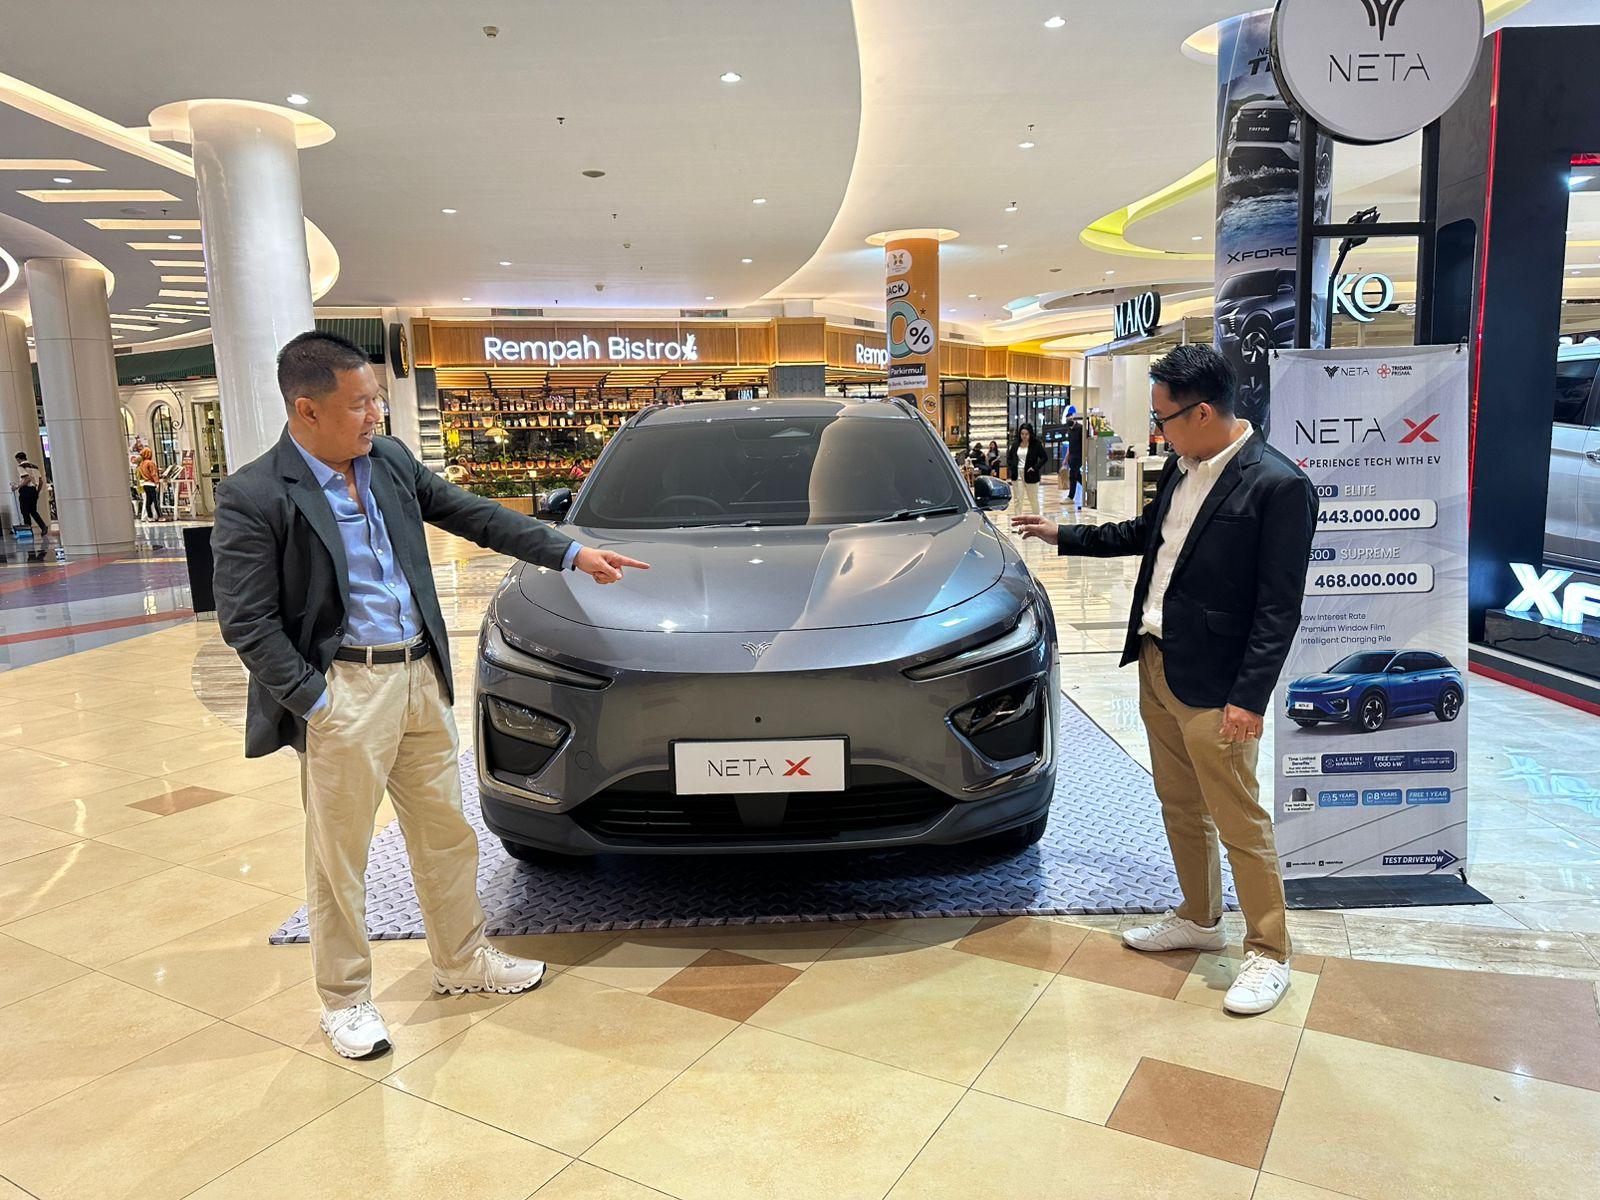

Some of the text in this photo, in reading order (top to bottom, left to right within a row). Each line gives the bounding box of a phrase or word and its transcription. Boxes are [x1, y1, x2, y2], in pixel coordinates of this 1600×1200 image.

[1329, 53, 1430, 82] NETA
[1114, 291, 1155, 337] MAKO
[484, 334, 681, 366] Rempah Bistro
[1340, 367, 1370, 376] NETA
[1295, 413, 1440, 445] NETA X
[1296, 456, 1441, 468] XPERIENCE TECH WITH EV
[1344, 484, 1376, 497] ELITE
[1317, 507, 1421, 524] 443.000.000
[1340, 546, 1401, 560] SUPREME
[1314, 572, 1418, 589] 468.000.000
[1301, 637, 1339, 645] Intelligent
[1340, 636, 1377, 644] Charging
[708, 756, 811, 777] NETA X
[1373, 792, 1380, 800] 8
